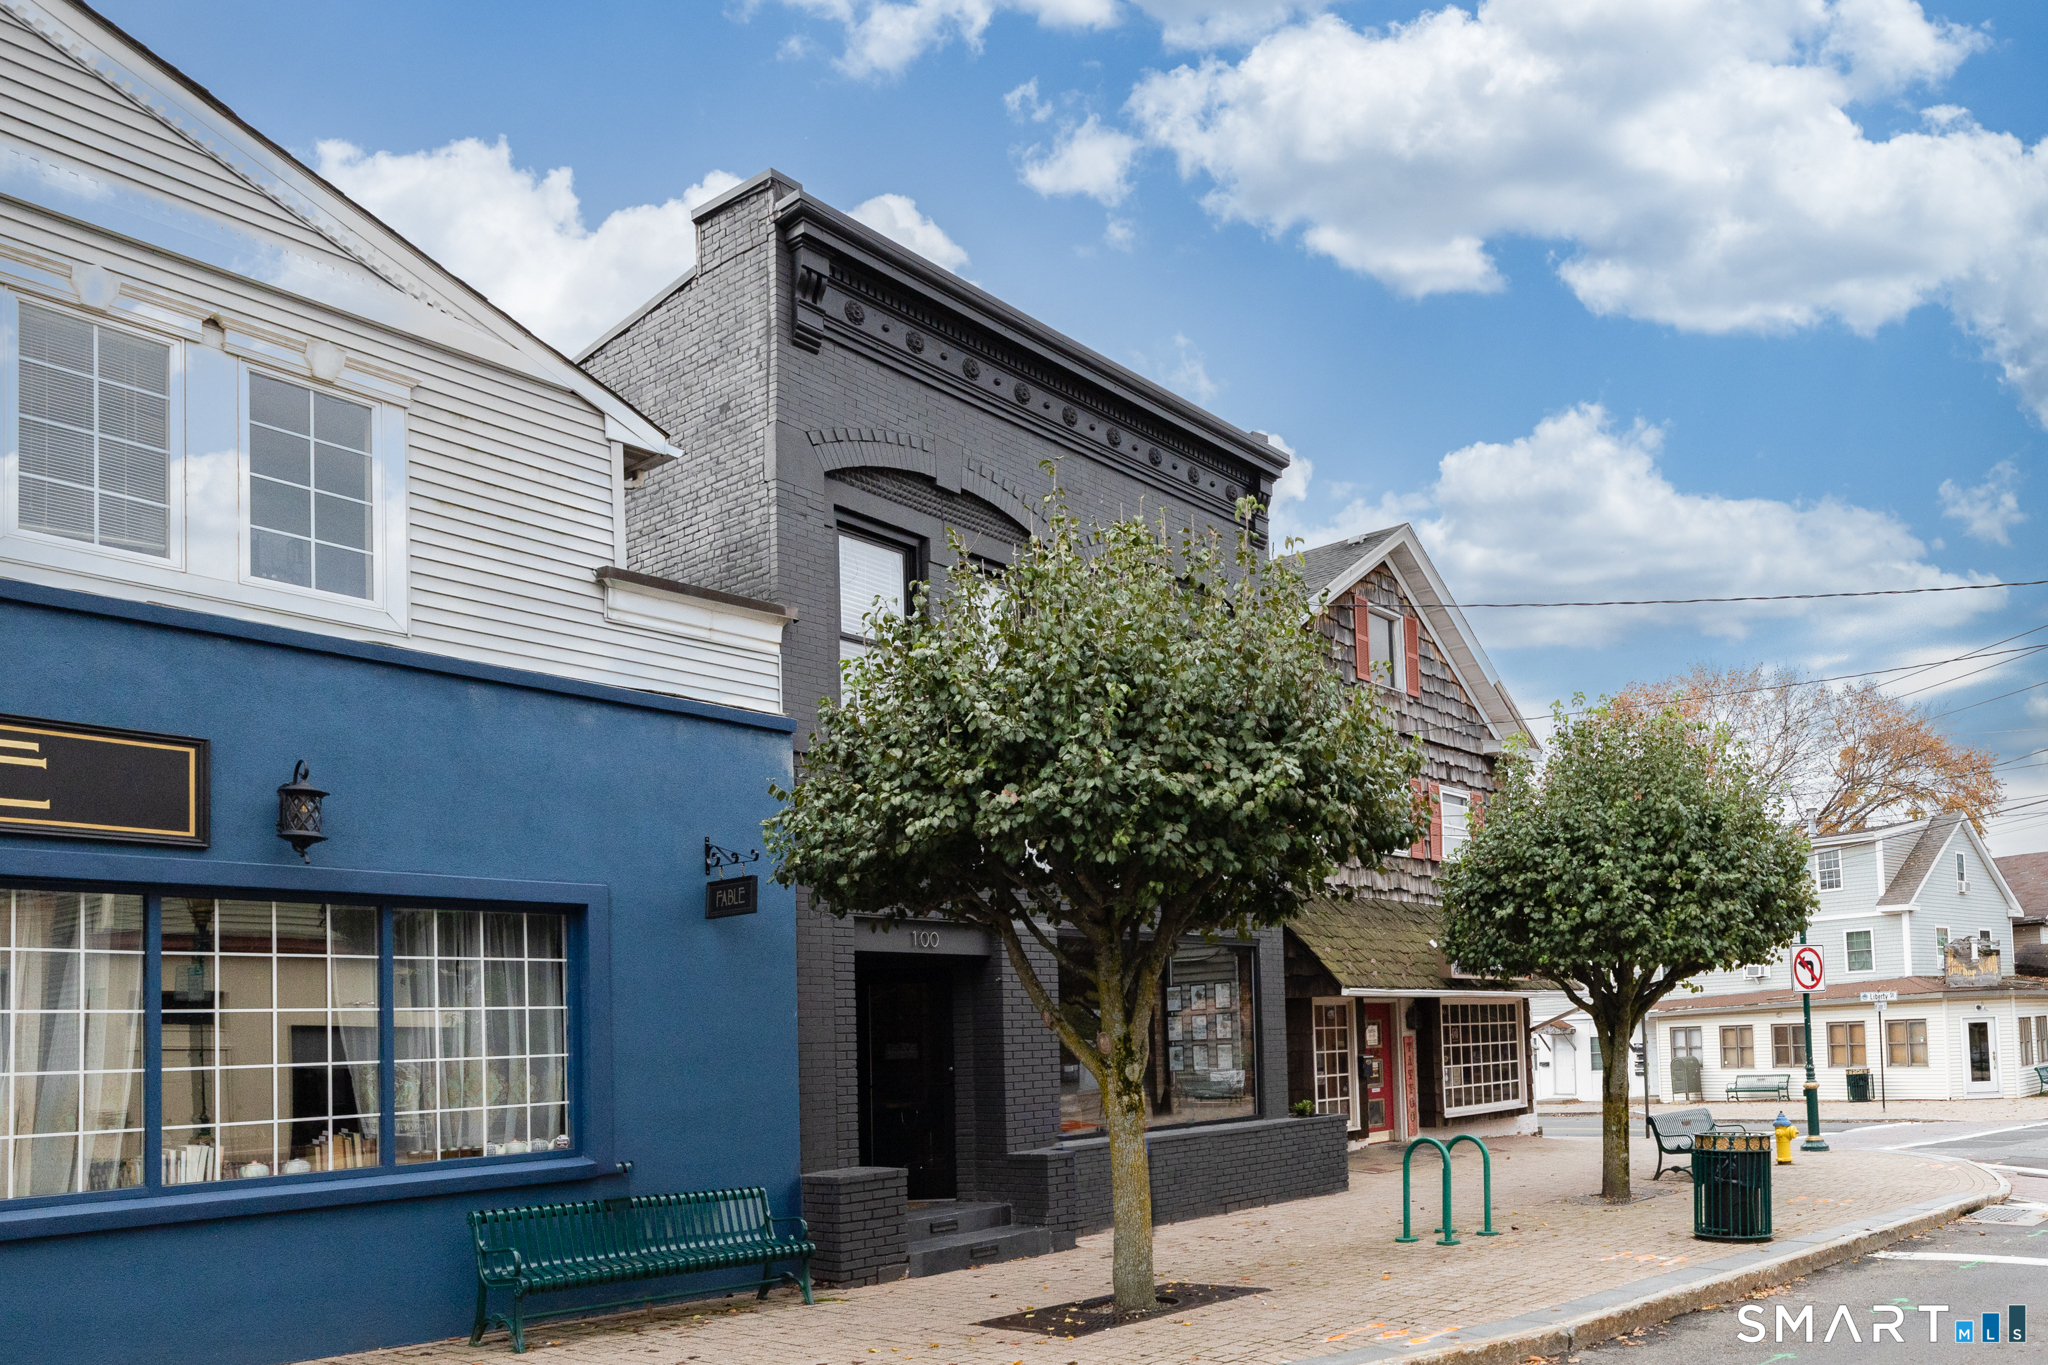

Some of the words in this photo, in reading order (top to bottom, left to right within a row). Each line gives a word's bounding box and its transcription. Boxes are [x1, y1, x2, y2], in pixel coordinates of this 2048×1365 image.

[716, 887, 746, 907] FABLE
[912, 930, 940, 948] 100
[1406, 1042, 1416, 1123] TATTOO
